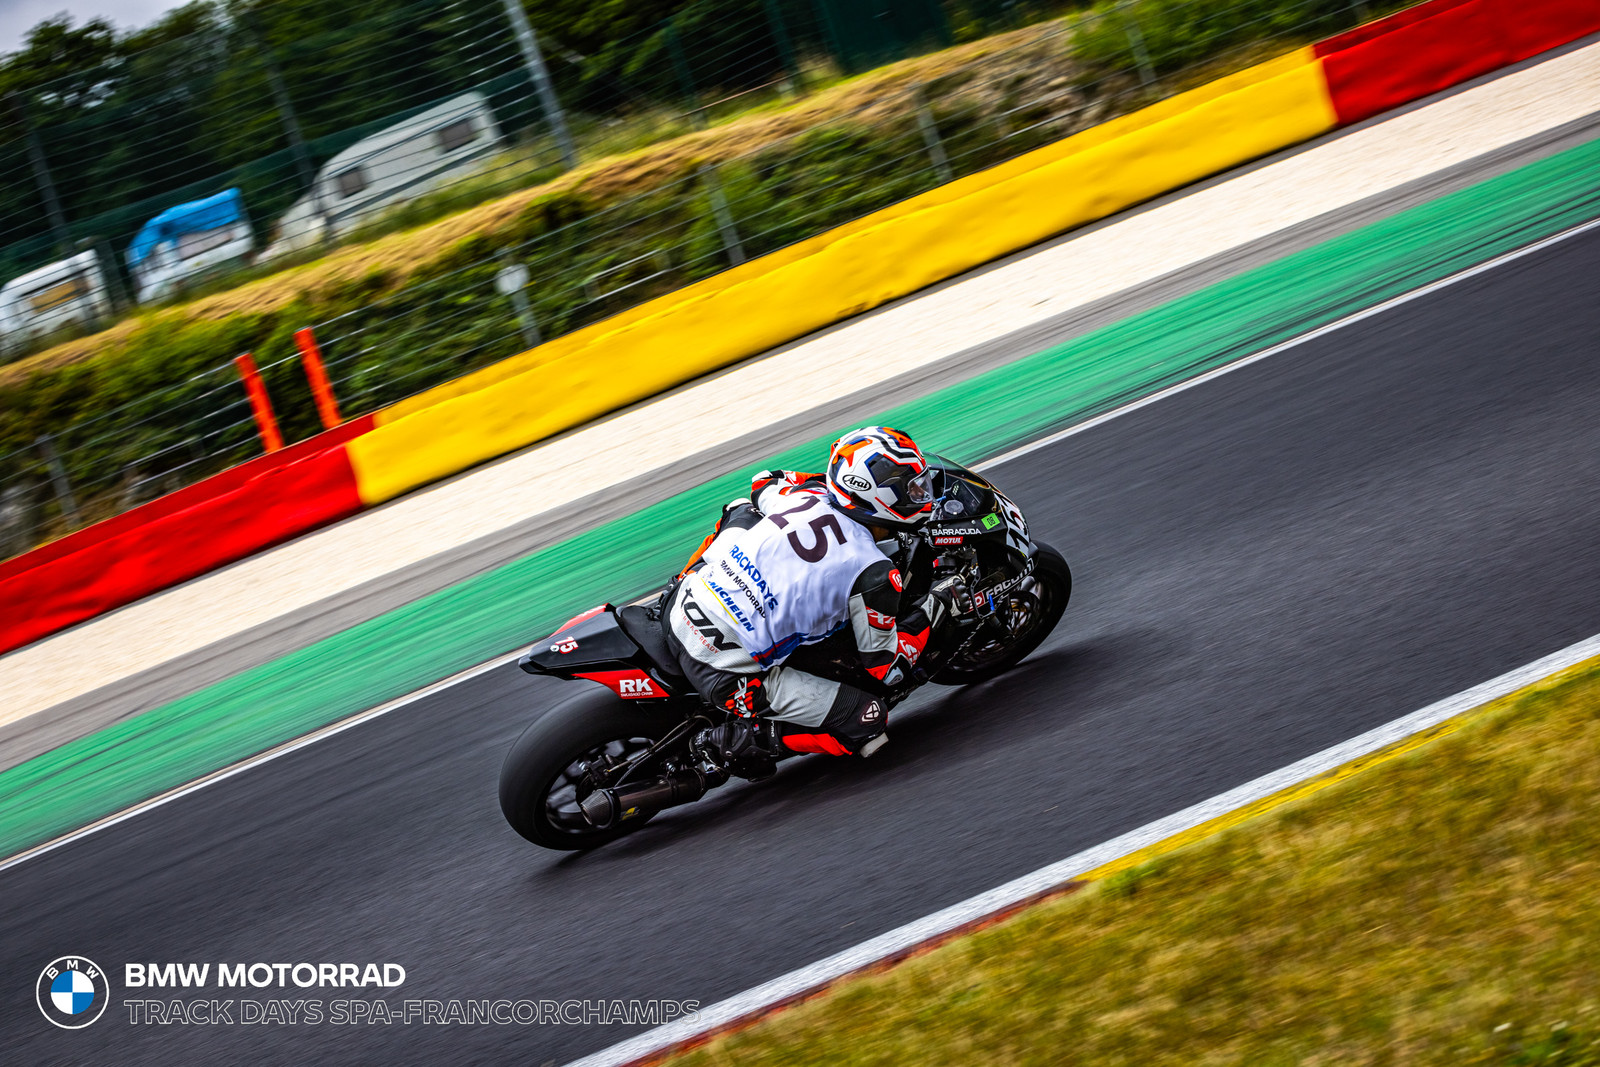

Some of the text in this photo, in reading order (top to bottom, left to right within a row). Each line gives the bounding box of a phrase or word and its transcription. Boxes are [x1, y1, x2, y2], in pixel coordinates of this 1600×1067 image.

[847, 476, 868, 489] Arai
[768, 495, 847, 563] 25
[931, 528, 982, 536] BARRACUDA
[729, 545, 779, 611] RACKDAYS
[733, 575, 766, 619] MOTORRAD
[699, 635, 720, 654] READY
[619, 678, 653, 693] RK
